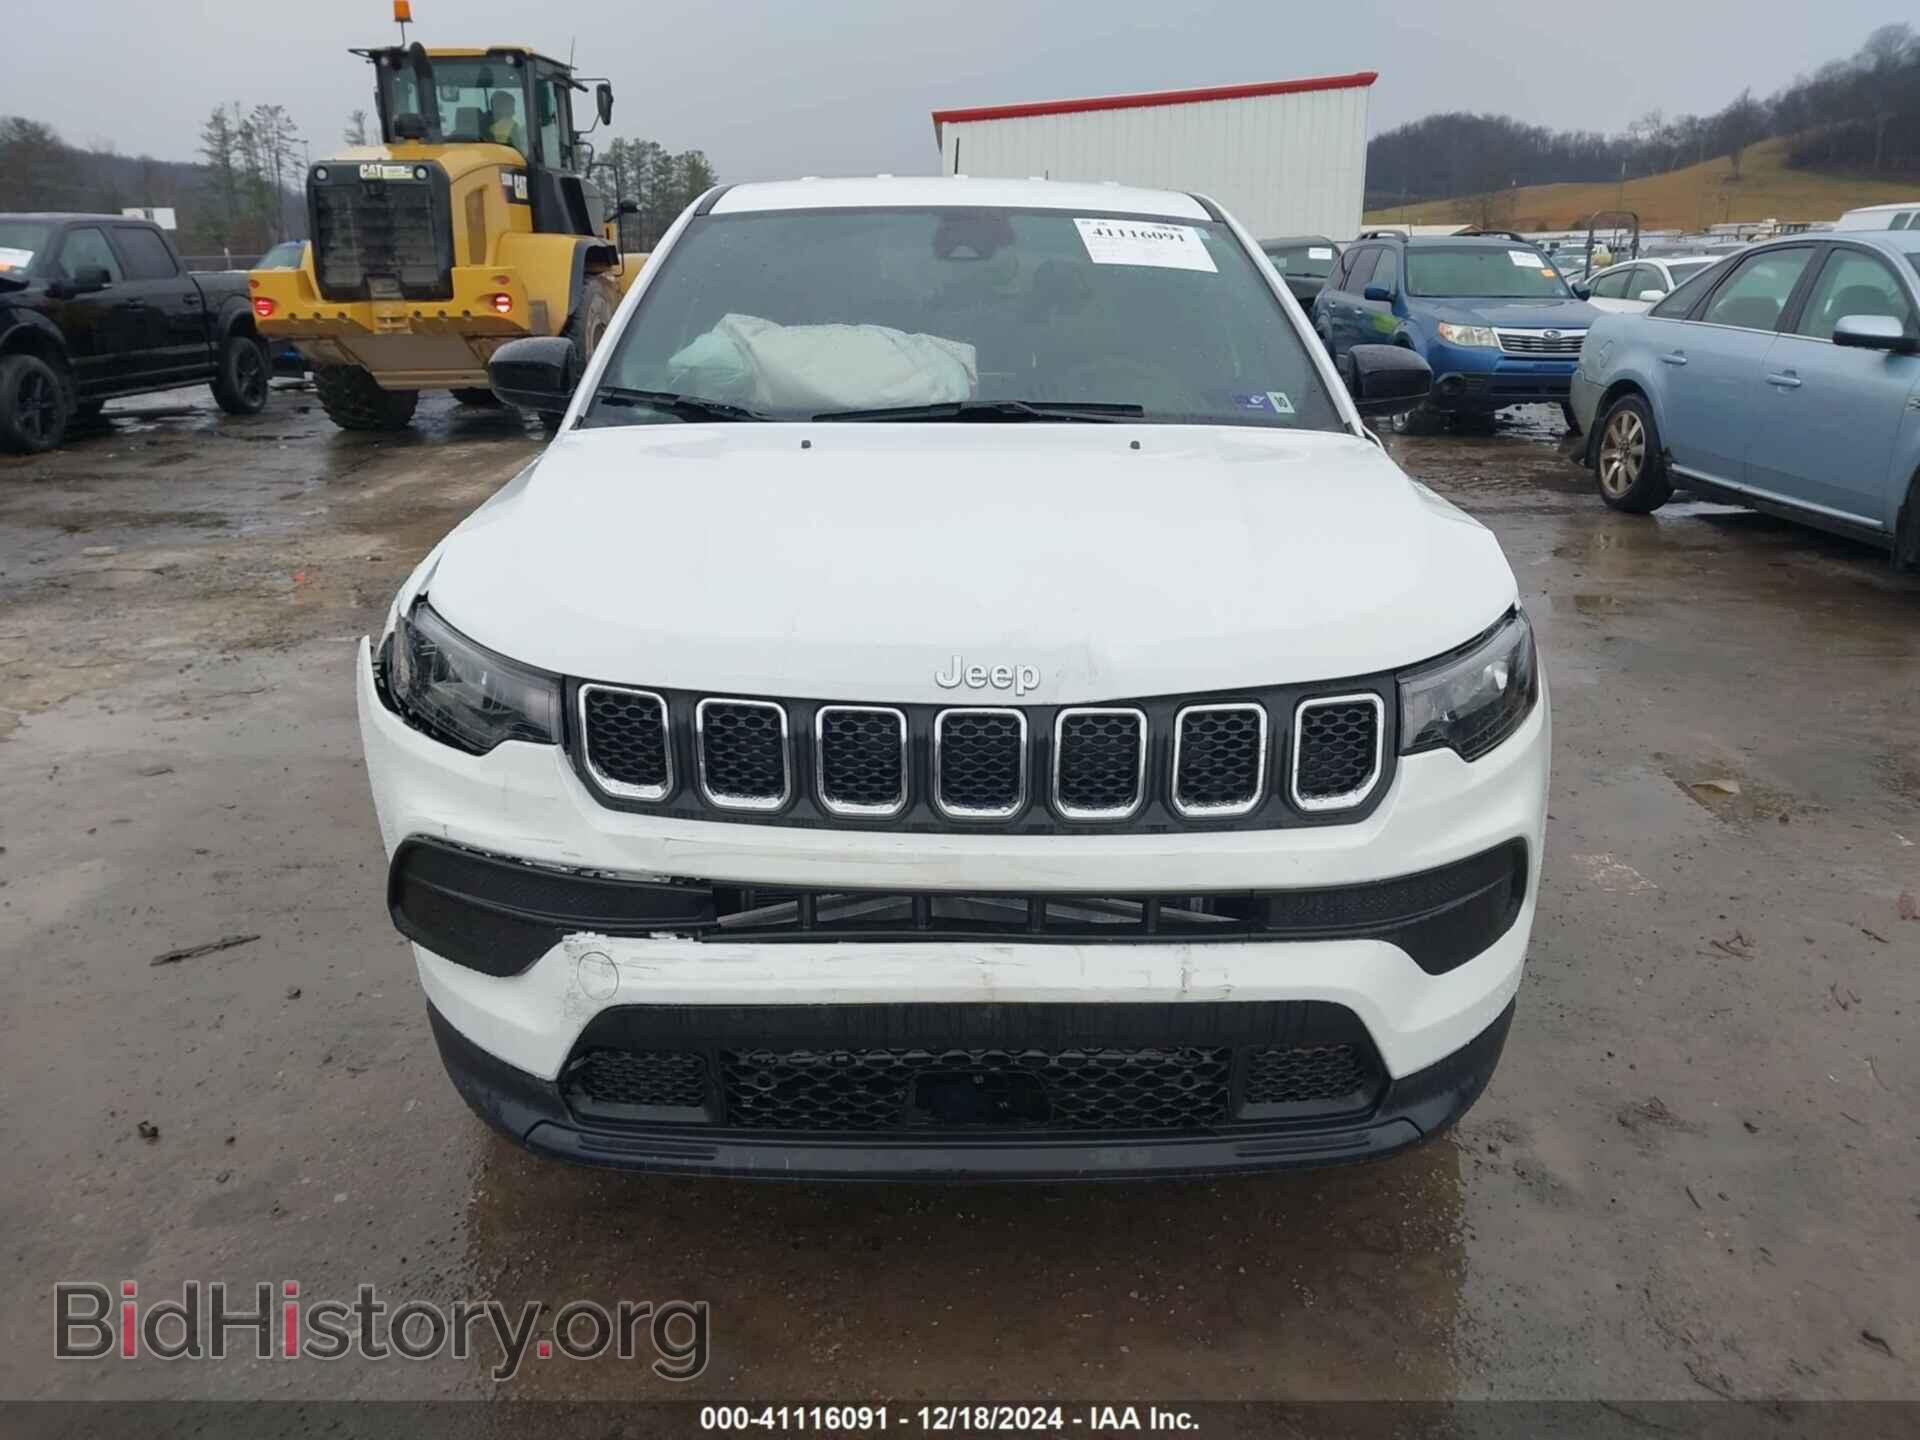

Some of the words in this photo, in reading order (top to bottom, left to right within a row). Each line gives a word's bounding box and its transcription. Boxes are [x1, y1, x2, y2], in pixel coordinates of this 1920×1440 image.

[359, 164, 383, 179] CAT
[1092, 227, 1185, 243] 41116091
[935, 655, 1041, 697] Jeep
